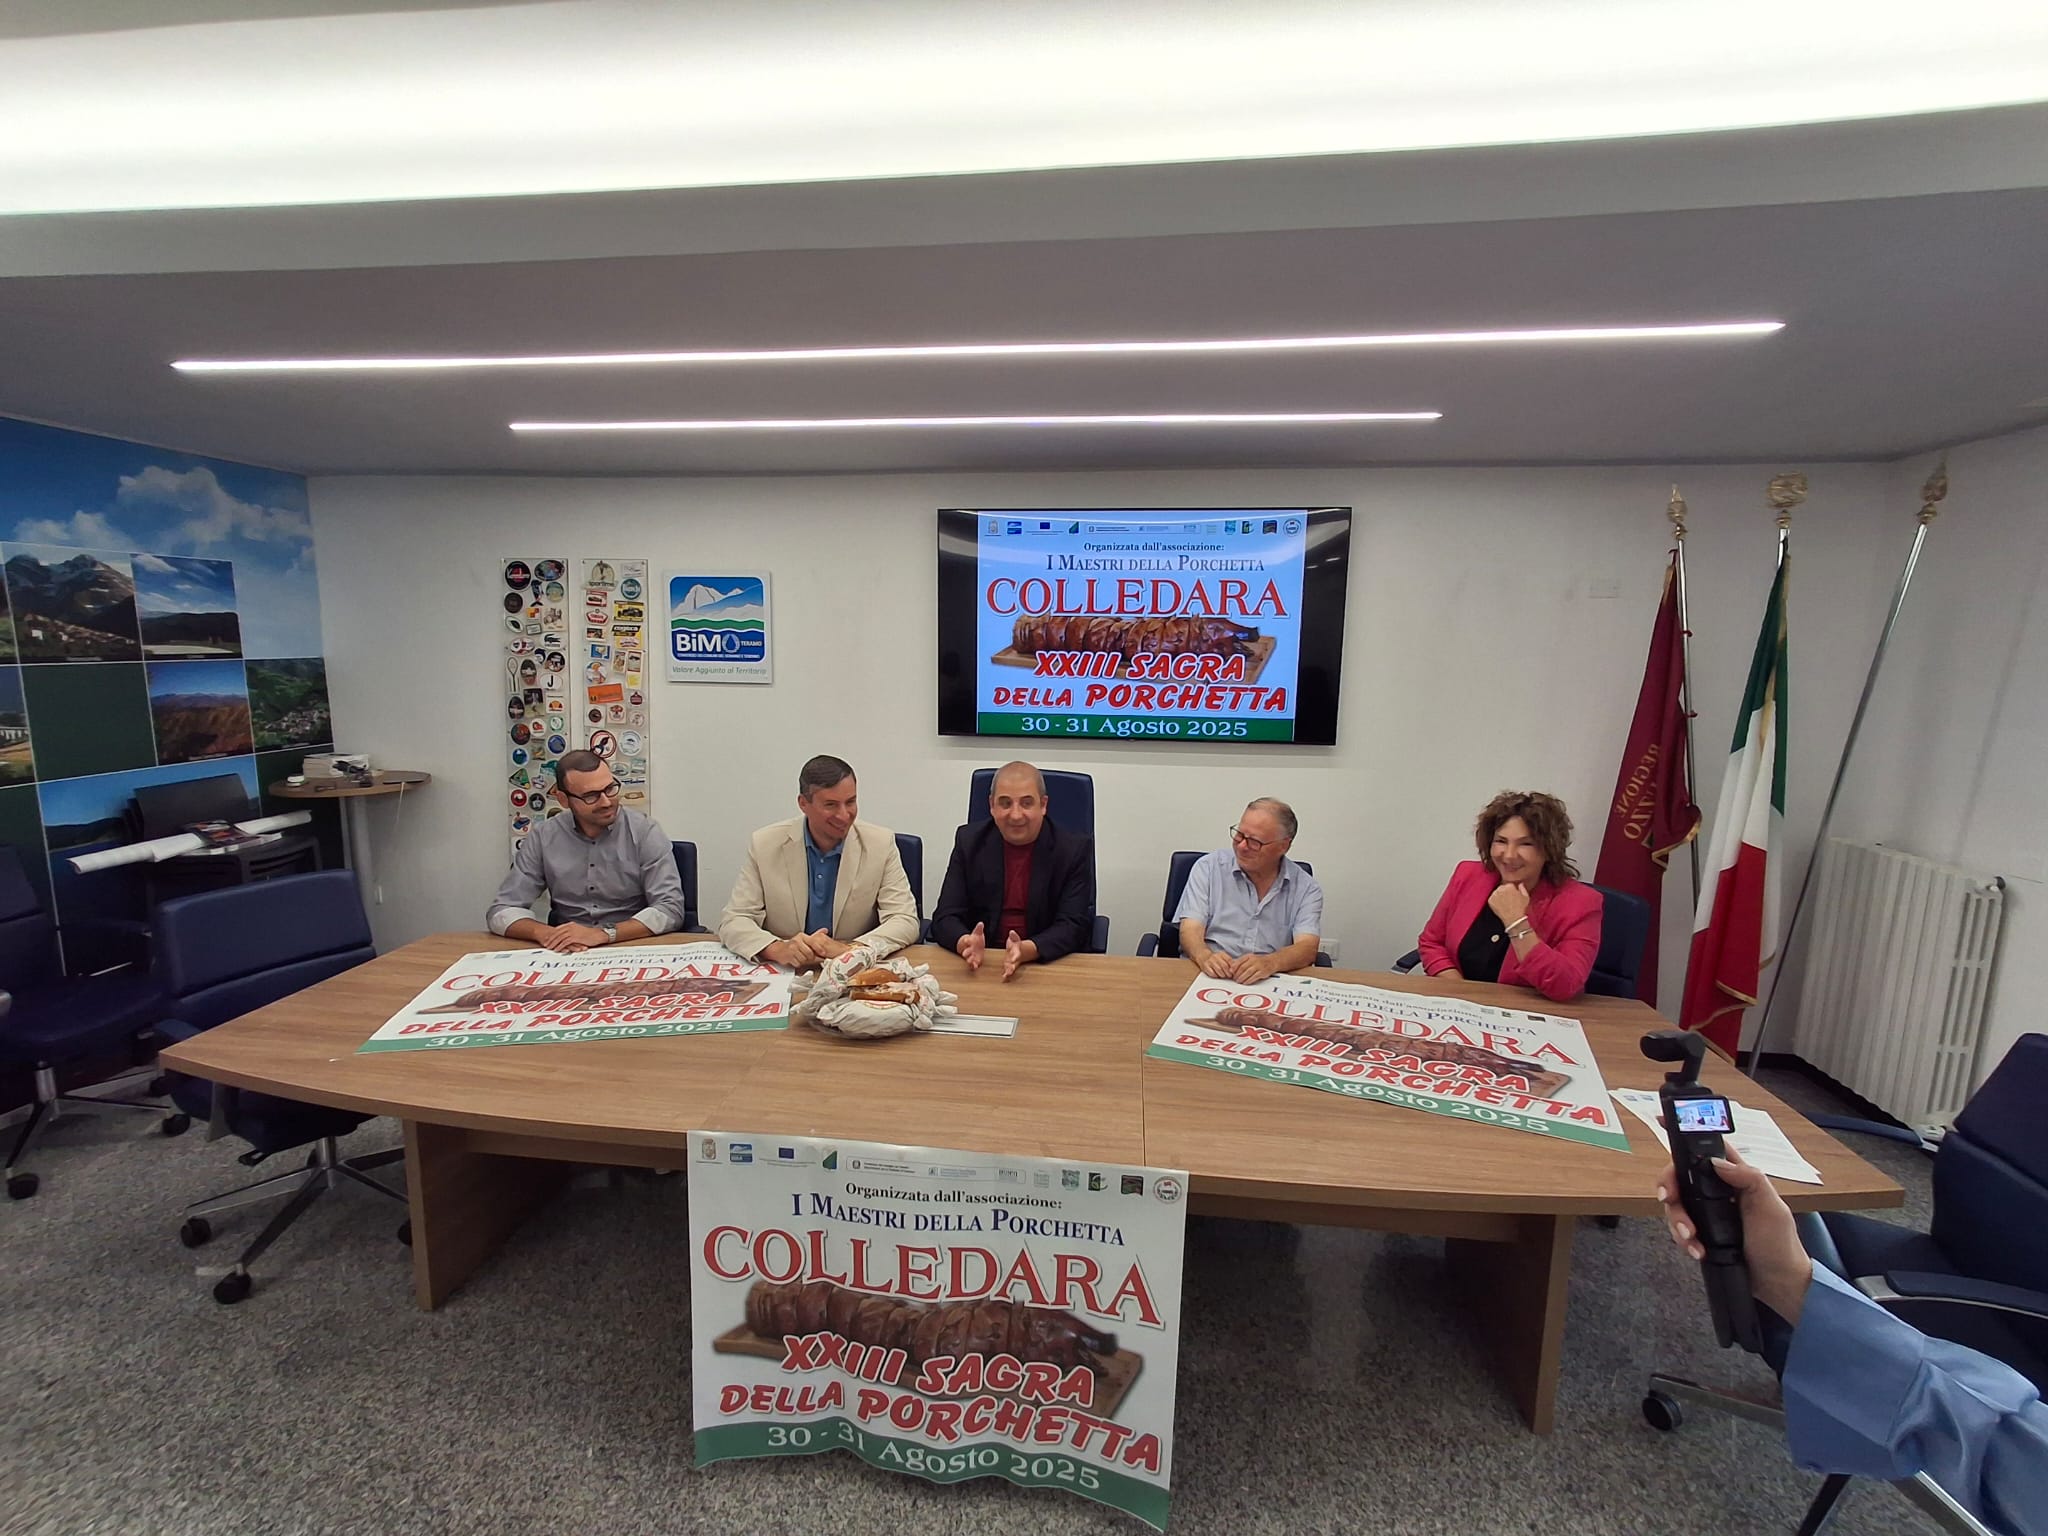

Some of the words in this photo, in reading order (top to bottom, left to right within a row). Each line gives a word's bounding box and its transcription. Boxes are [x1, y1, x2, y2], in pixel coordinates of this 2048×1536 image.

[1046, 555, 1053, 571] I
[1057, 555, 1124, 571] MAESTRI
[1128, 558, 1174, 571] DELLA
[1177, 555, 1265, 572] PORCHETTA
[1083, 542, 1139, 552] Organizzata
[1141, 542, 1225, 552] dall'associazione:
[986, 578, 1289, 616] COLLEDARA
[695, 666, 726, 675] Aggiunto
[1033, 651, 1122, 678] XXIII
[1126, 652, 1245, 682] SAGRA
[992, 686, 1073, 707] DELLA
[1084, 683, 1288, 712] PORCHETTA
[1021, 718, 1050, 733] 30
[1065, 718, 1089, 733] 31
[1099, 719, 1180, 737] Agosto
[1187, 720, 1248, 737] 2025
[441, 963, 781, 991] COLLEDARA
[541, 958, 612, 968] MAESTRI
[618, 957, 665, 965] DELLA
[398, 1019, 514, 1035] DELLA
[526, 1002, 783, 1029] PORCHETTA
[472, 998, 589, 1015] XXIII
[590, 992, 734, 1011] SAGRA
[1285, 989, 1360, 1007] MAESTRI
[1366, 1002, 1419, 1018] DELLA
[1427, 1012, 1537, 1036] PORCHETTA
[425, 1035, 470, 1047] 30
[491, 1032, 525, 1043] 31
[535, 1026, 647, 1041] Agosto
[657, 1021, 734, 1034] 2025
[1196, 987, 1581, 1066] COLLEDARA
[1237, 1025, 1352, 1057] XXIII
[1360, 1048, 1531, 1093] SAGRA
[1175, 1034, 1285, 1063] DELLA
[1297, 1053, 1609, 1127] PORCHETTA
[1206, 1056, 1247, 1071] 30
[1268, 1068, 1301, 1081] 31
[1315, 1077, 1439, 1110] Agosto
[1450, 1103, 1550, 1132] 2025
[845, 1182, 930, 1205] Organizzata
[933, 1189, 1063, 1210] dall'associazione:
[791, 1193, 803, 1216] I
[810, 1192, 906, 1230] MAESTRI
[914, 1213, 983, 1232] DELLA
[991, 1209, 1125, 1247] PORCHETTA
[703, 1225, 1164, 1330] COLLEDARA
[780, 1331, 907, 1385] XXIII
[916, 1353, 1095, 1406] SAGRA
[718, 1381, 844, 1415] DELLA
[855, 1388, 1163, 1474] PORCHETTA
[767, 1426, 812, 1448] 30
[838, 1423, 865, 1452] 31
[879, 1440, 1000, 1475] Agosto
[1009, 1454, 1101, 1491] 2025
